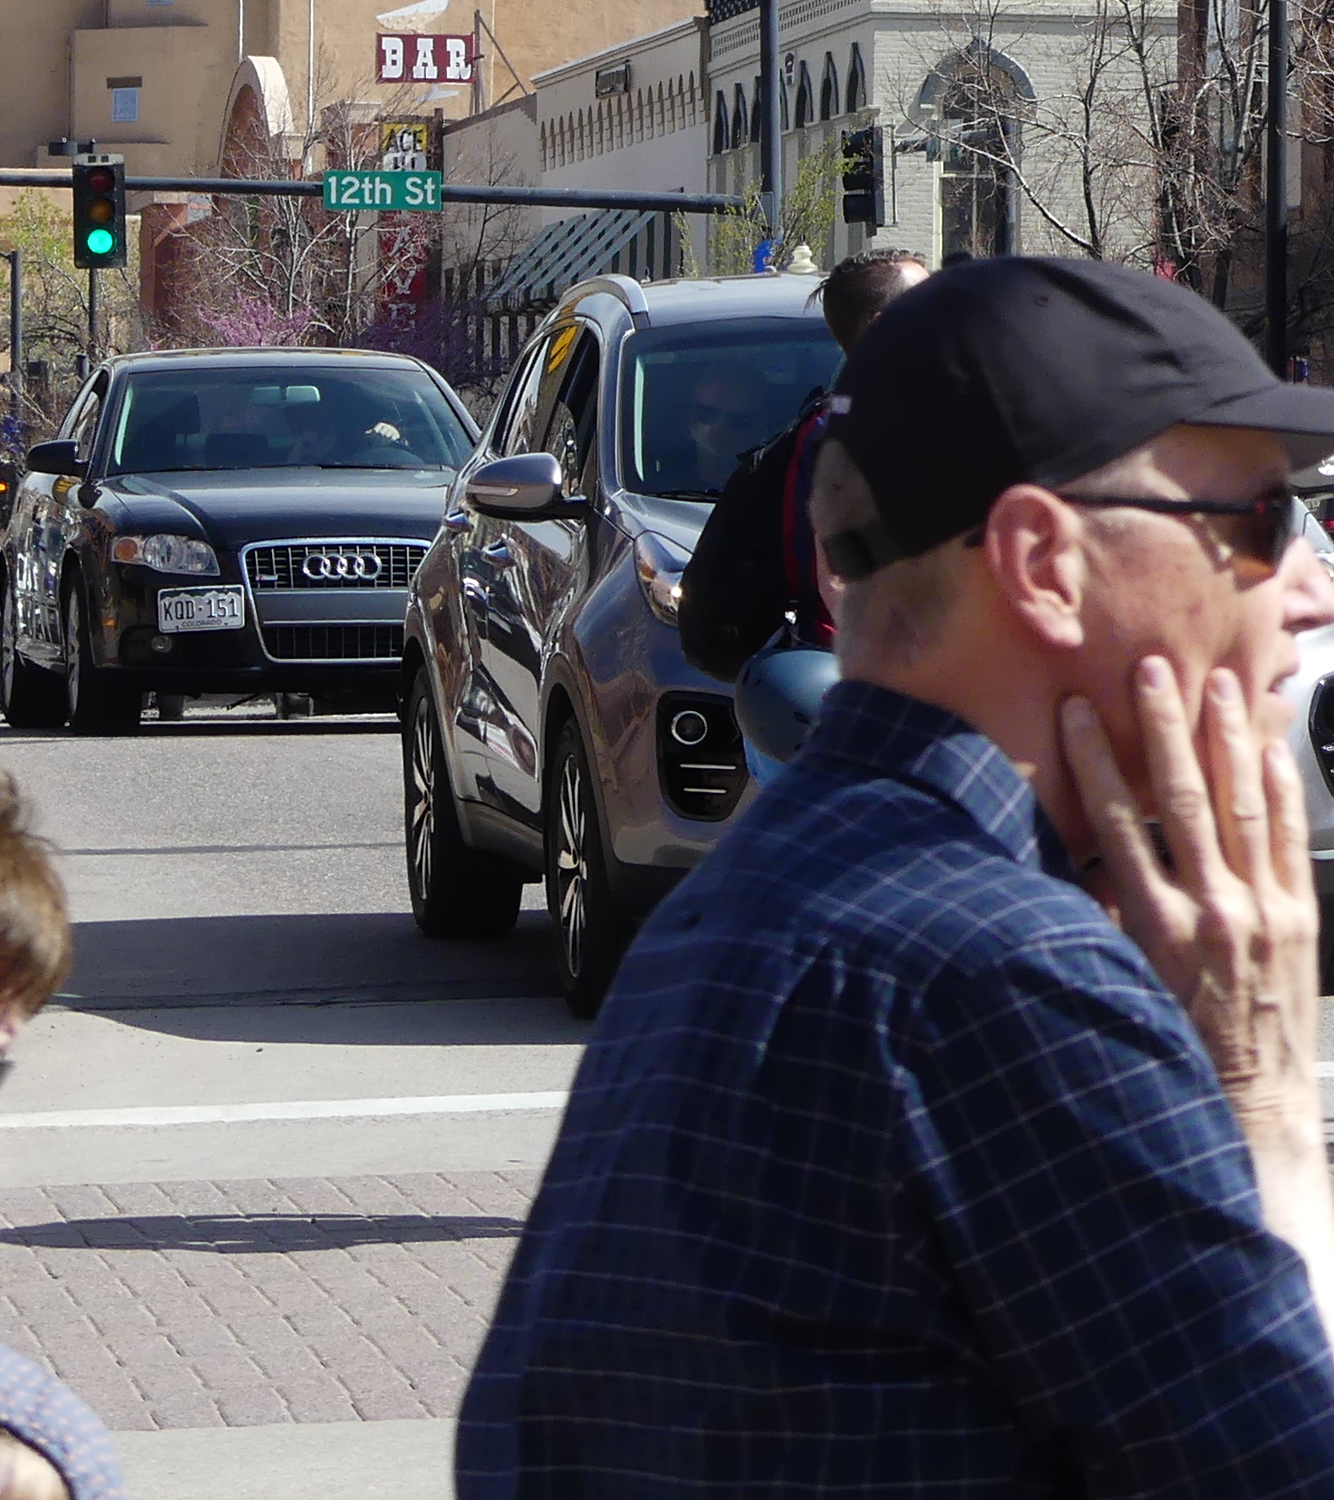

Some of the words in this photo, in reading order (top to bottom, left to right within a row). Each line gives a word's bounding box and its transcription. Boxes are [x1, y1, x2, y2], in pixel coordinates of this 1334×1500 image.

[381, 37, 471, 80] BAR
[384, 128, 424, 153] ACE
[328, 176, 393, 205] 12th
[403, 177, 437, 206] St
